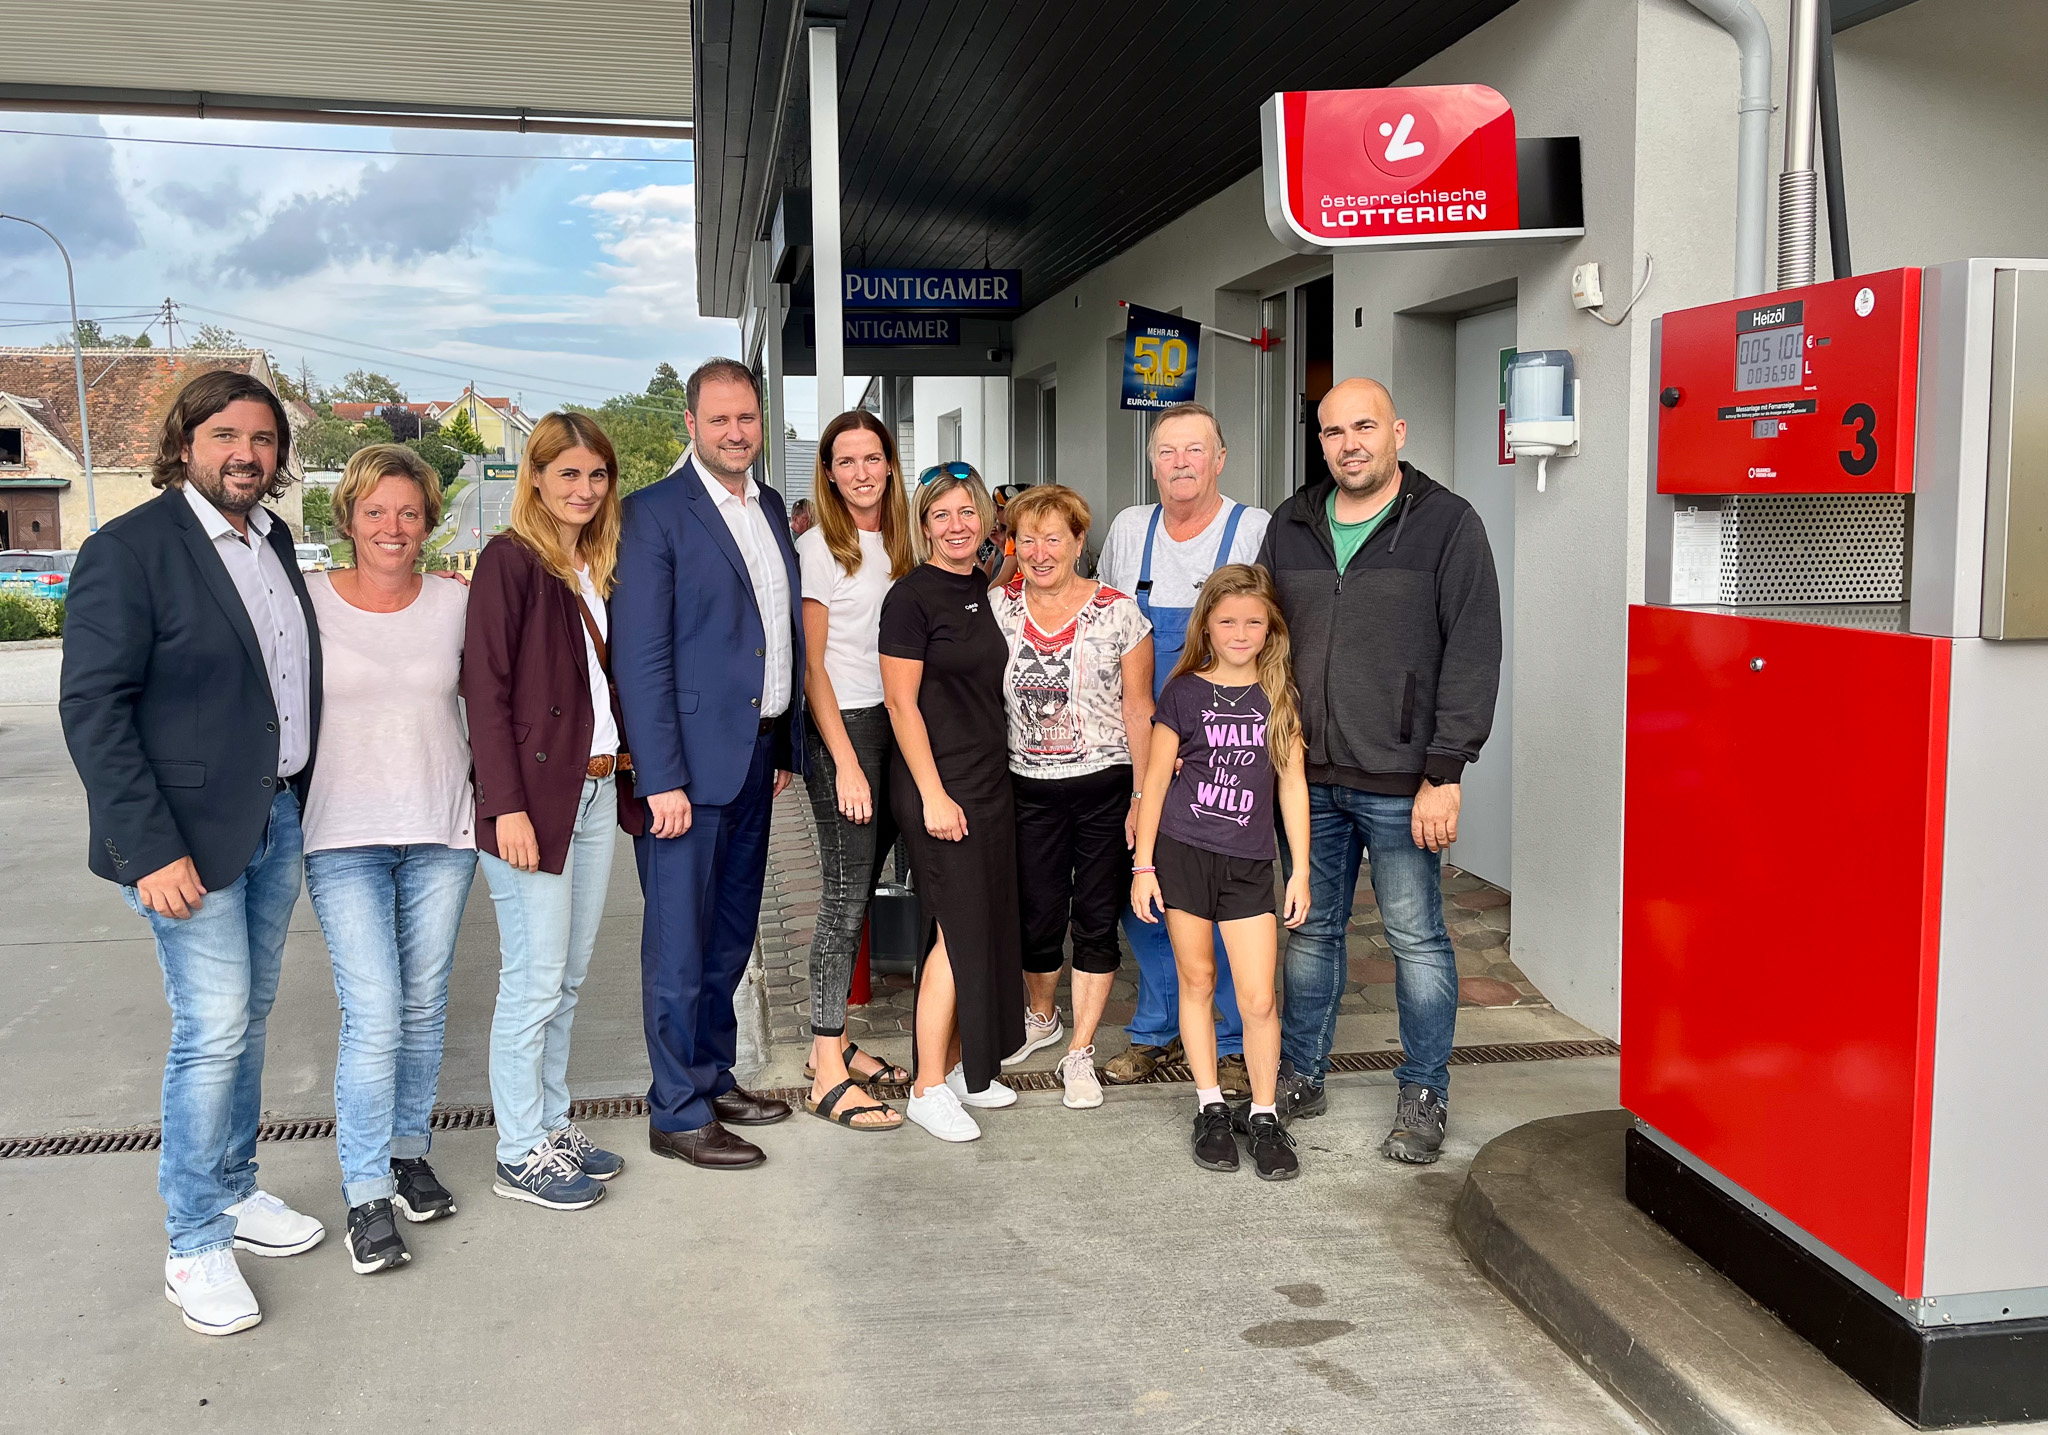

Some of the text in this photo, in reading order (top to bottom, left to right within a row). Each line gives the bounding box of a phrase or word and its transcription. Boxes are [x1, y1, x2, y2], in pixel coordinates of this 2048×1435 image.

[1320, 187, 1487, 208] österreichische
[1321, 203, 1488, 228] LOTTERIEN
[845, 273, 1009, 300] PUNTIGAMER
[1752, 307, 1786, 327] Heizöl
[845, 319, 949, 339] NTIGAMER
[1147, 327, 1179, 338] MEHR ALS
[1133, 336, 1188, 377] 50
[1804, 361, 1812, 374] L
[1838, 402, 1878, 476] 3
[1204, 723, 1267, 747] WALK
[1208, 749, 1256, 768] INTO
[1213, 766, 1241, 787] The
[1196, 781, 1254, 813] WILD
